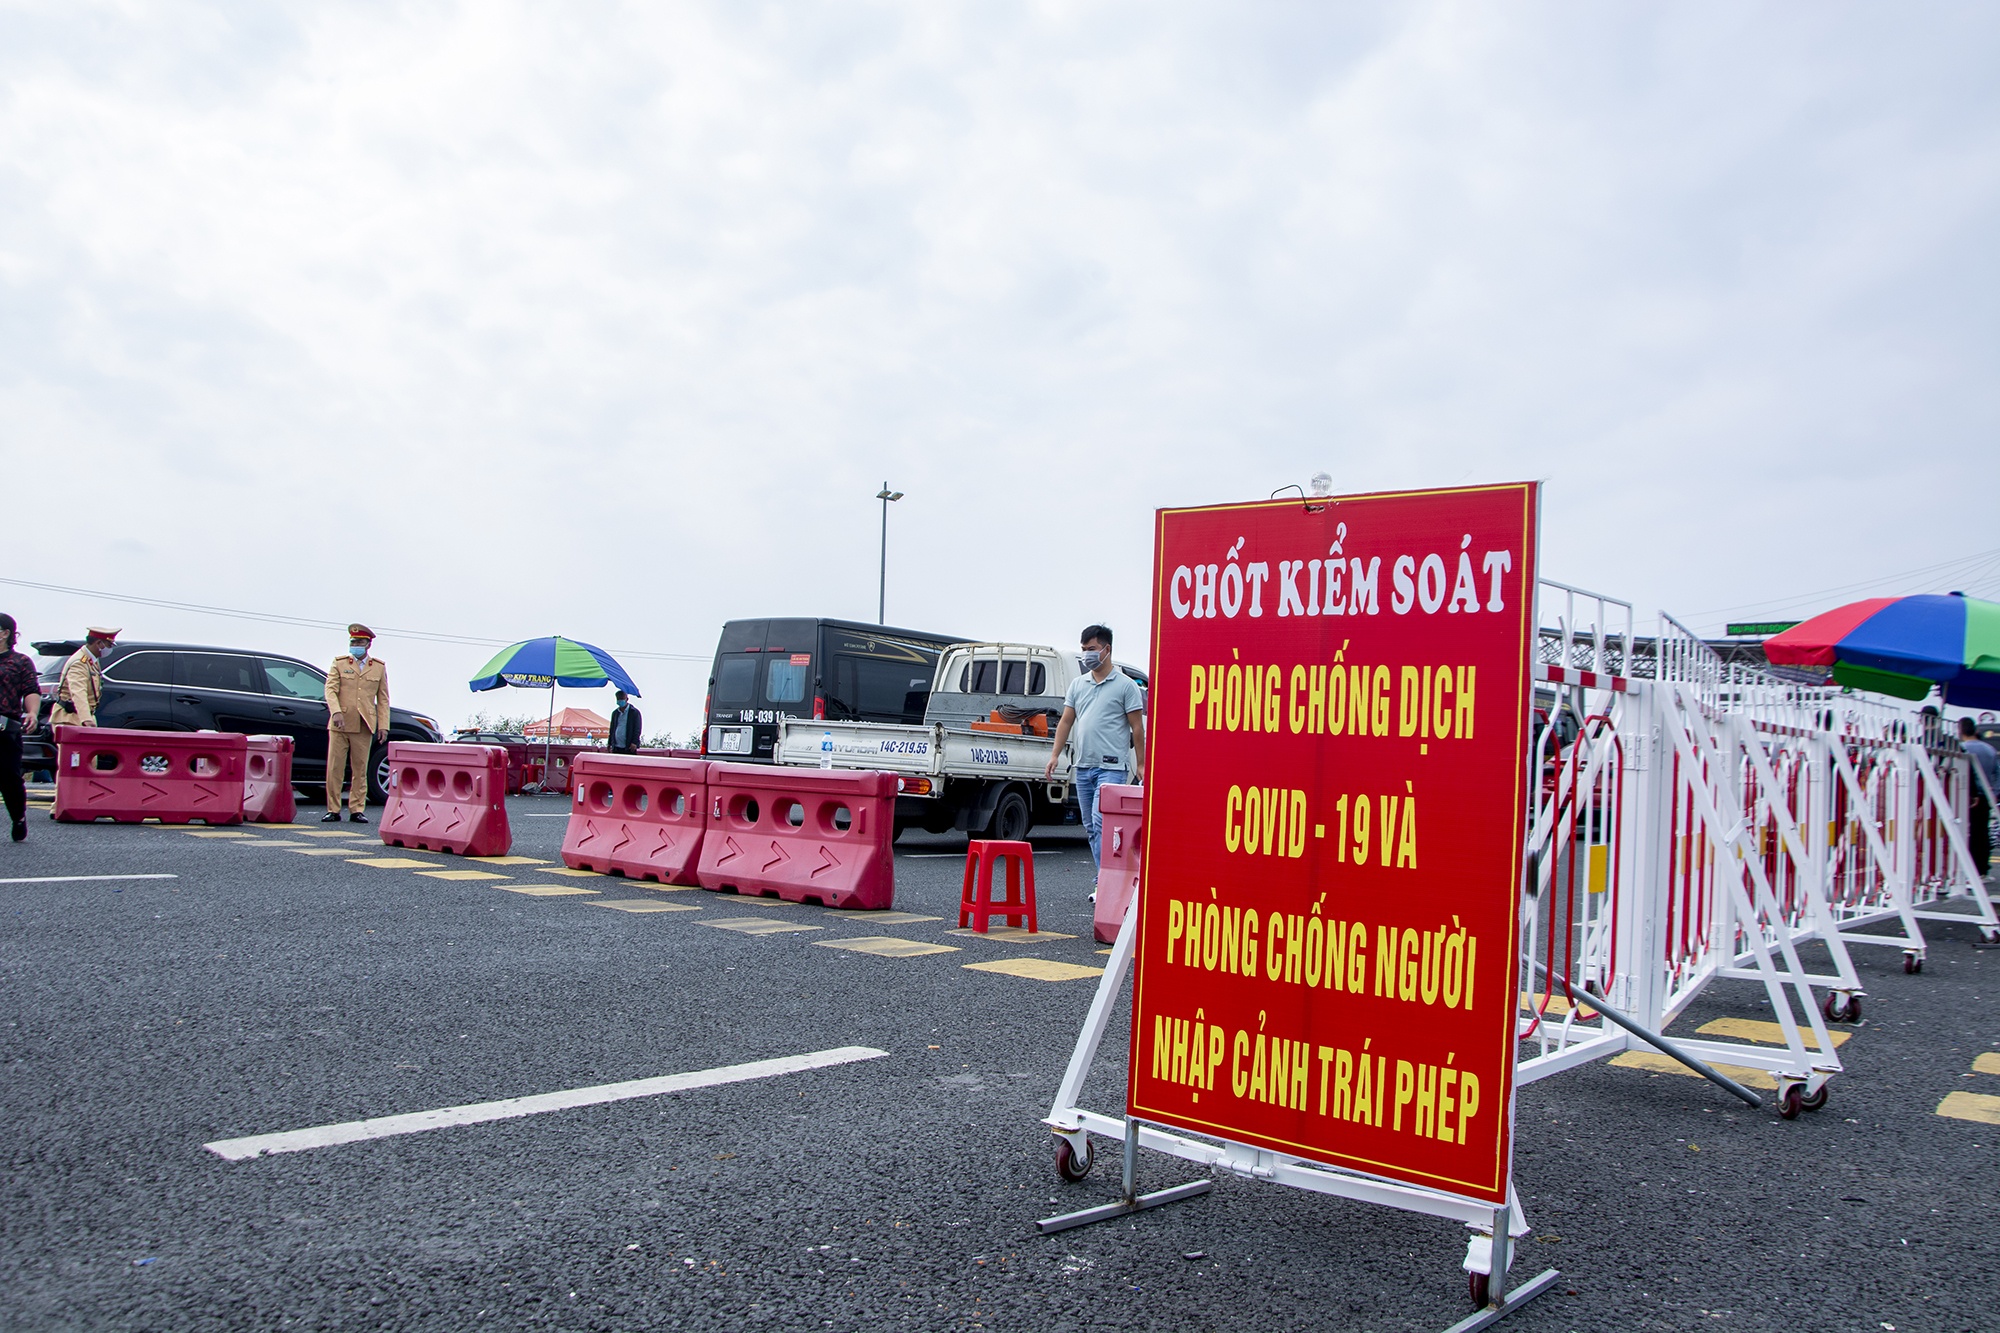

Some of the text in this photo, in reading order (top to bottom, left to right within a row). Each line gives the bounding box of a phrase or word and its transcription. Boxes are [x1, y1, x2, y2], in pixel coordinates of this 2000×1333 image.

[1170, 521, 1512, 619] CHỐT KIỂM SOÁT
[527, 674, 551, 683] TRANG
[1188, 639, 1477, 756] PHÒNG CHỐNG DỊCH
[880, 740, 928, 755] 14C-219.55
[970, 748, 1009, 765] 14C-219.55
[1225, 784, 1307, 859] COVID
[1336, 793, 1371, 866] 19
[1380, 780, 1418, 870] VÀ
[1167, 886, 1477, 1011] PHÒNG CHỐNG NGƯỜI
[1151, 1007, 1481, 1146] NHẬP CẢNH TRÁI PHÉP
